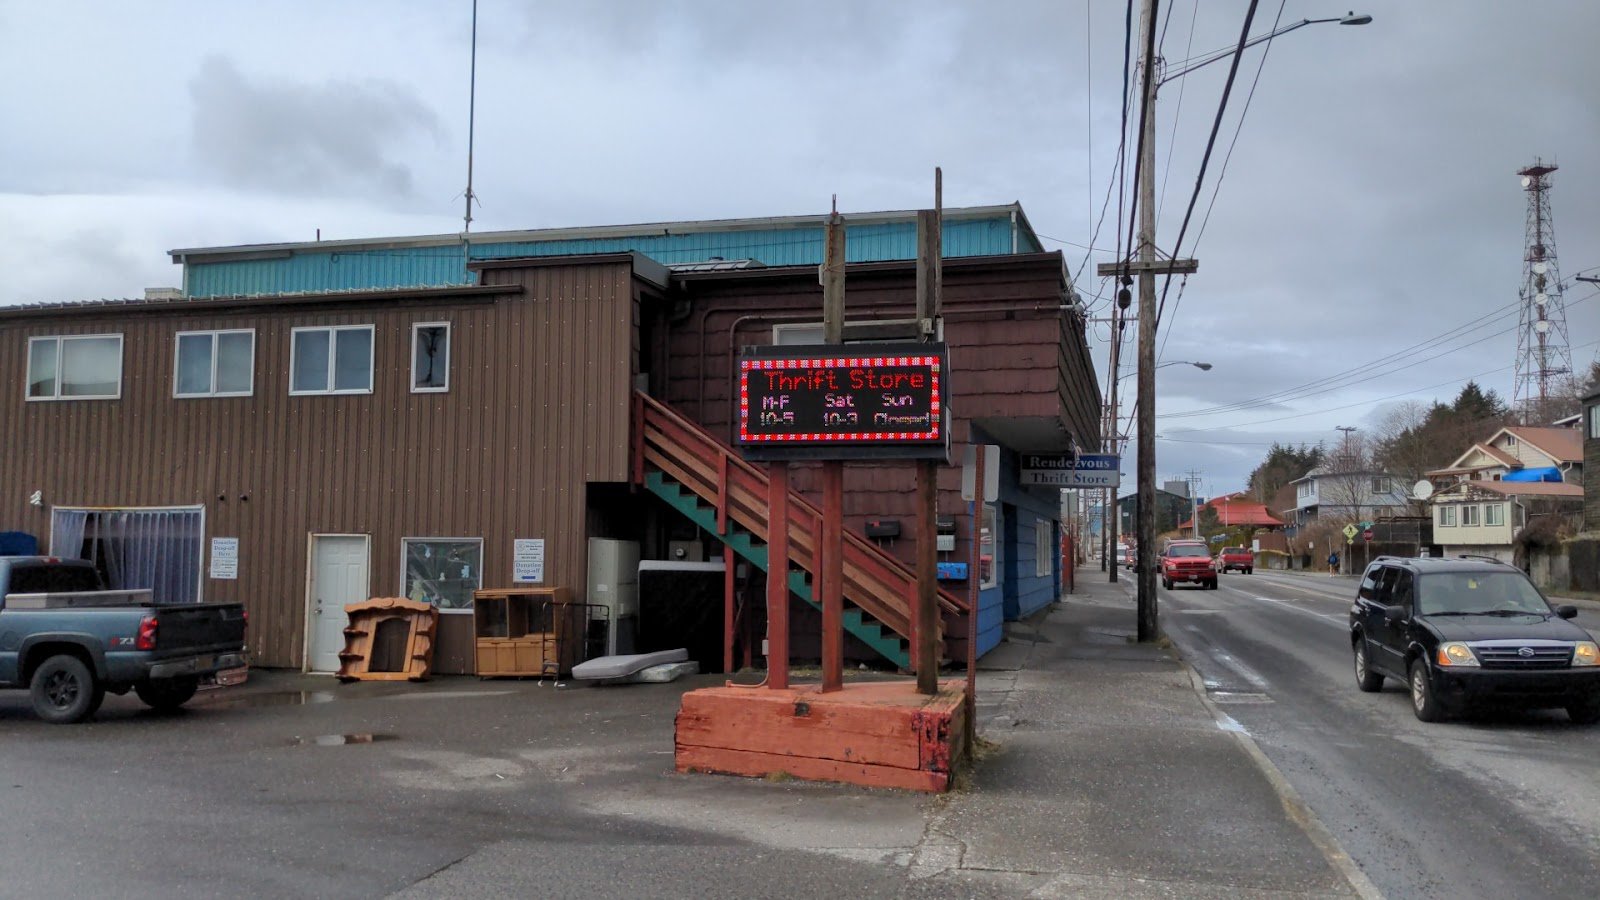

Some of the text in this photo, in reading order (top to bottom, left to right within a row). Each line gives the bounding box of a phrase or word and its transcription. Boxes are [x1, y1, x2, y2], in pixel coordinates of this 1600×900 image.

[764, 369, 924, 390] Thrift Store
[762, 392, 913, 410] M-F Sat Sun
[760, 411, 795, 427] 10-5
[1030, 455, 1110, 469] Rendezvous
[1030, 472, 1109, 484] Thrift Store
